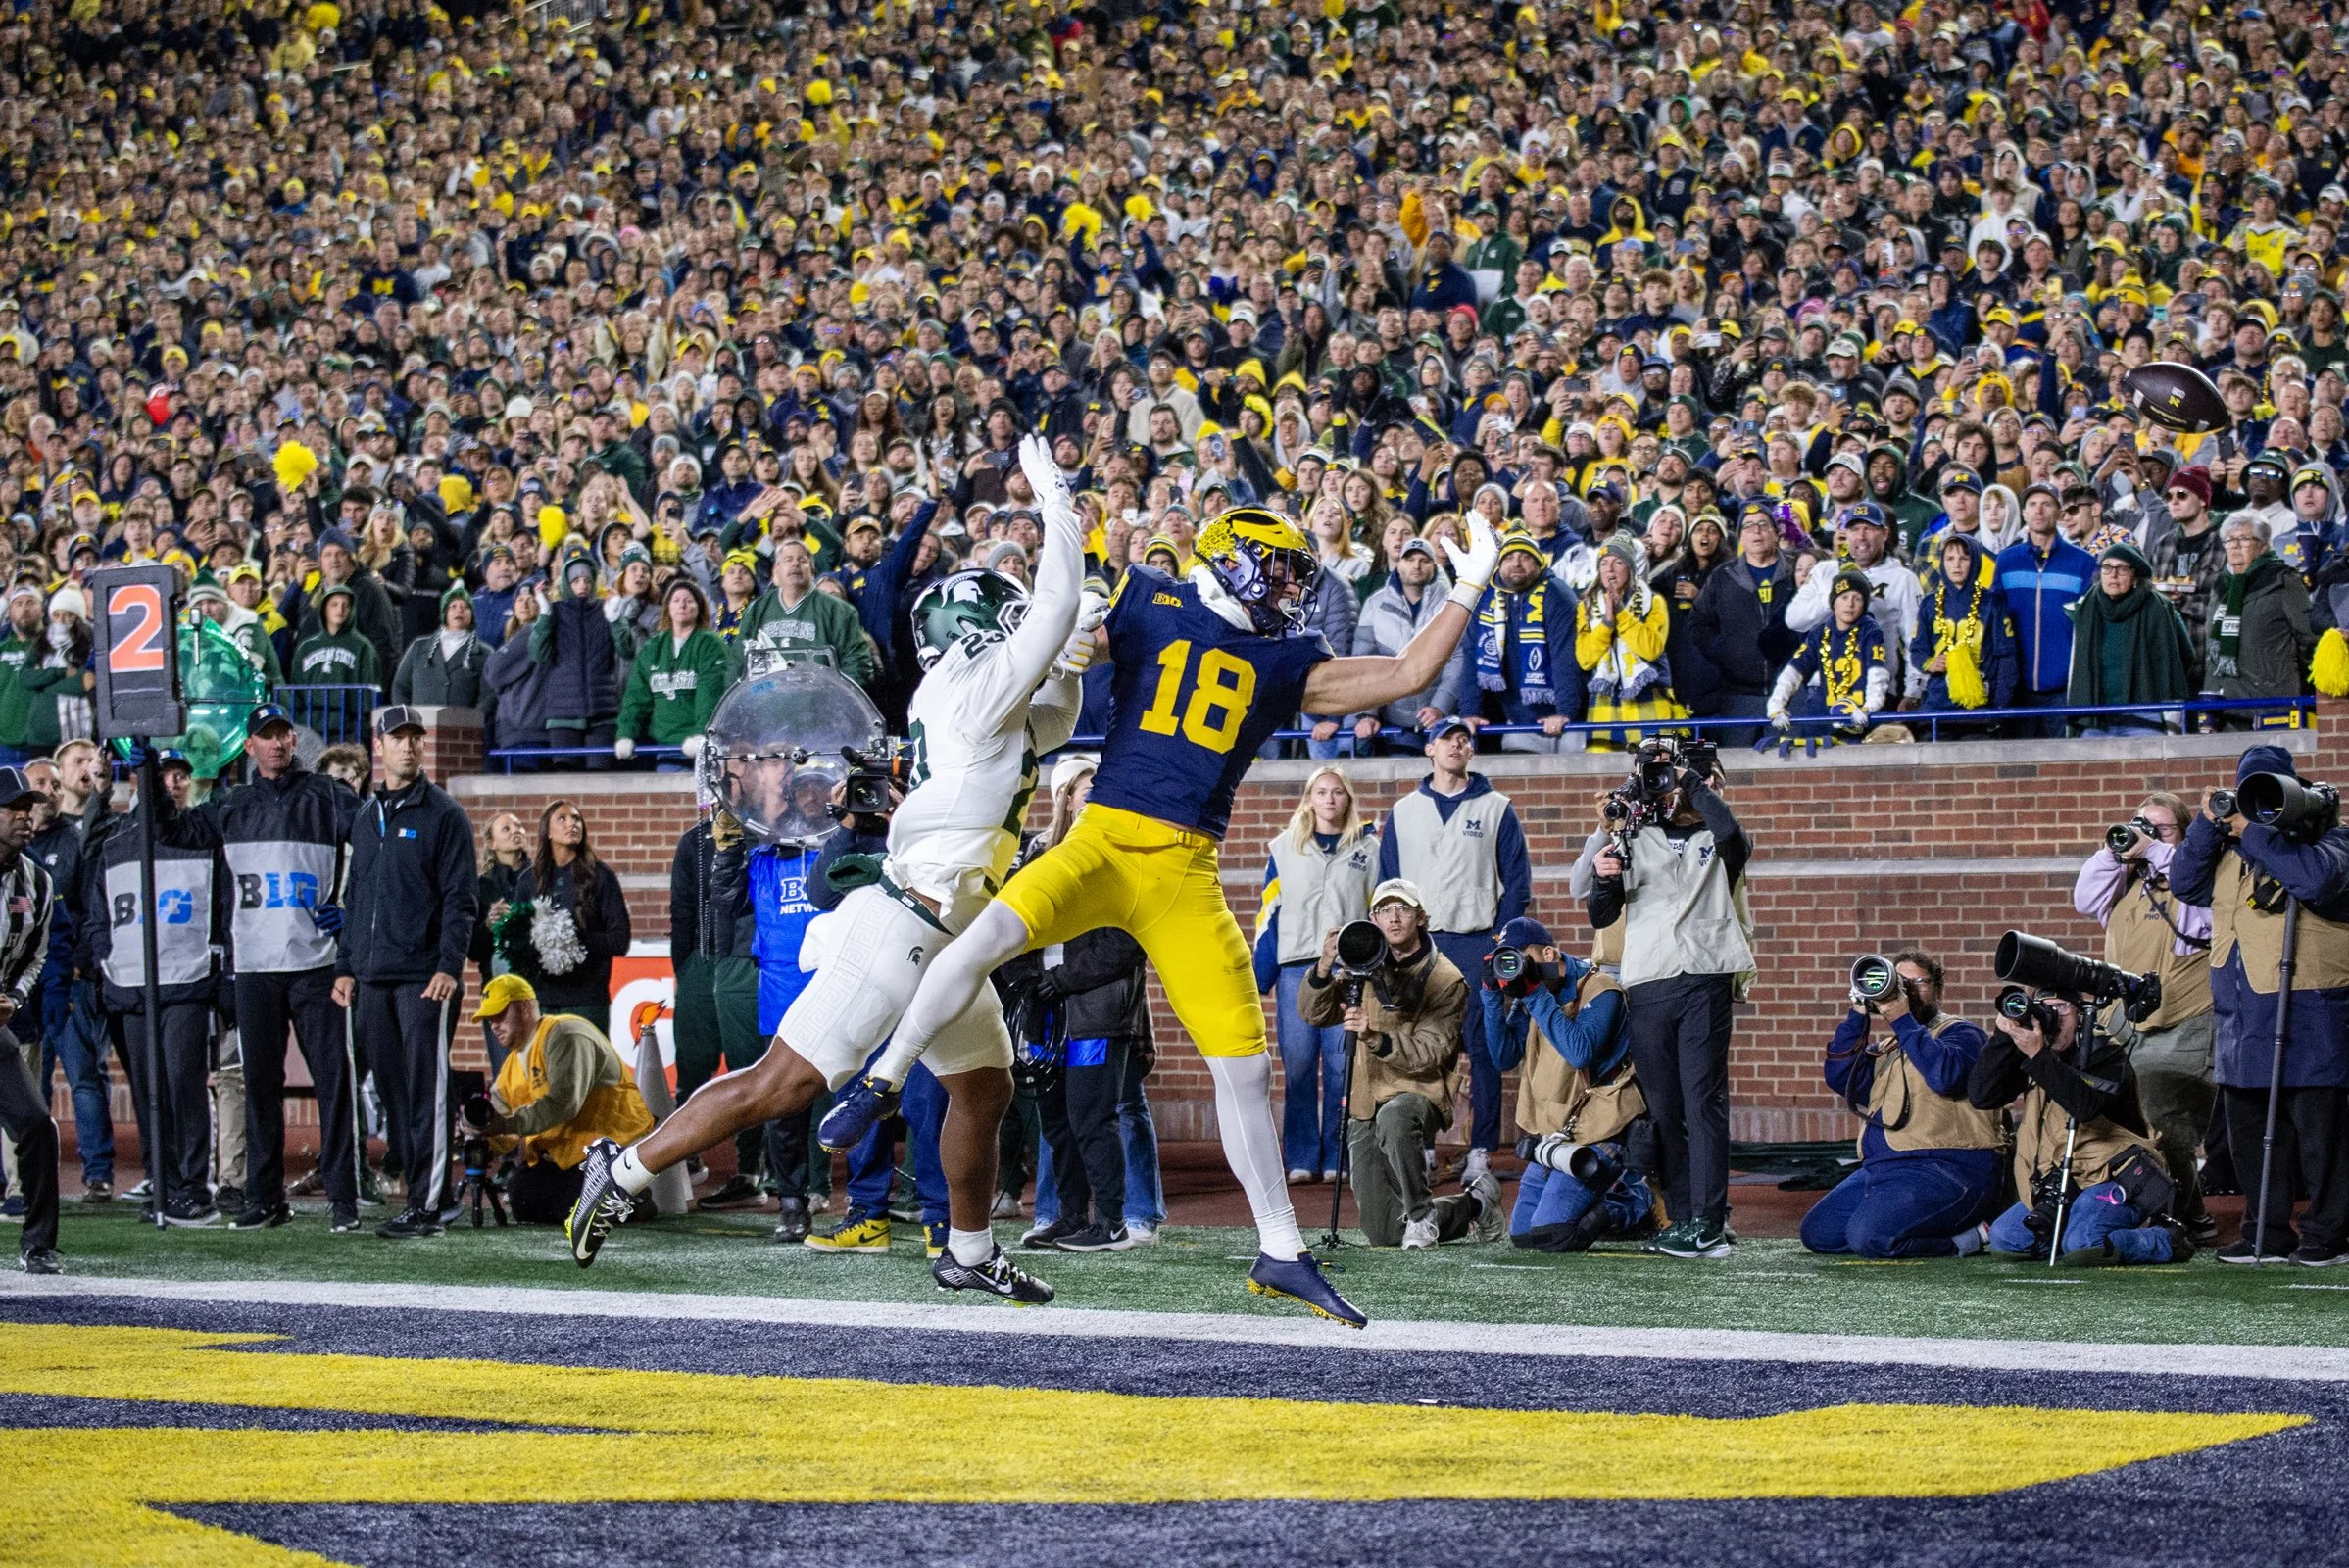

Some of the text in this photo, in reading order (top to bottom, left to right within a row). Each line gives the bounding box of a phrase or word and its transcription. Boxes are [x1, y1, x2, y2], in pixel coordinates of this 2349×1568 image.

[108, 584, 165, 673] 2
[1872, 645, 1886, 663] 12
[1139, 639, 1257, 755] 18
[1465, 819, 1482, 830] M
[1462, 830, 1484, 839] VIDEO
[1347, 861, 1367, 872] VIDEO
[1352, 851, 1368, 864] M
[237, 871, 318, 909] BIG
[113, 888, 193, 929] BG
